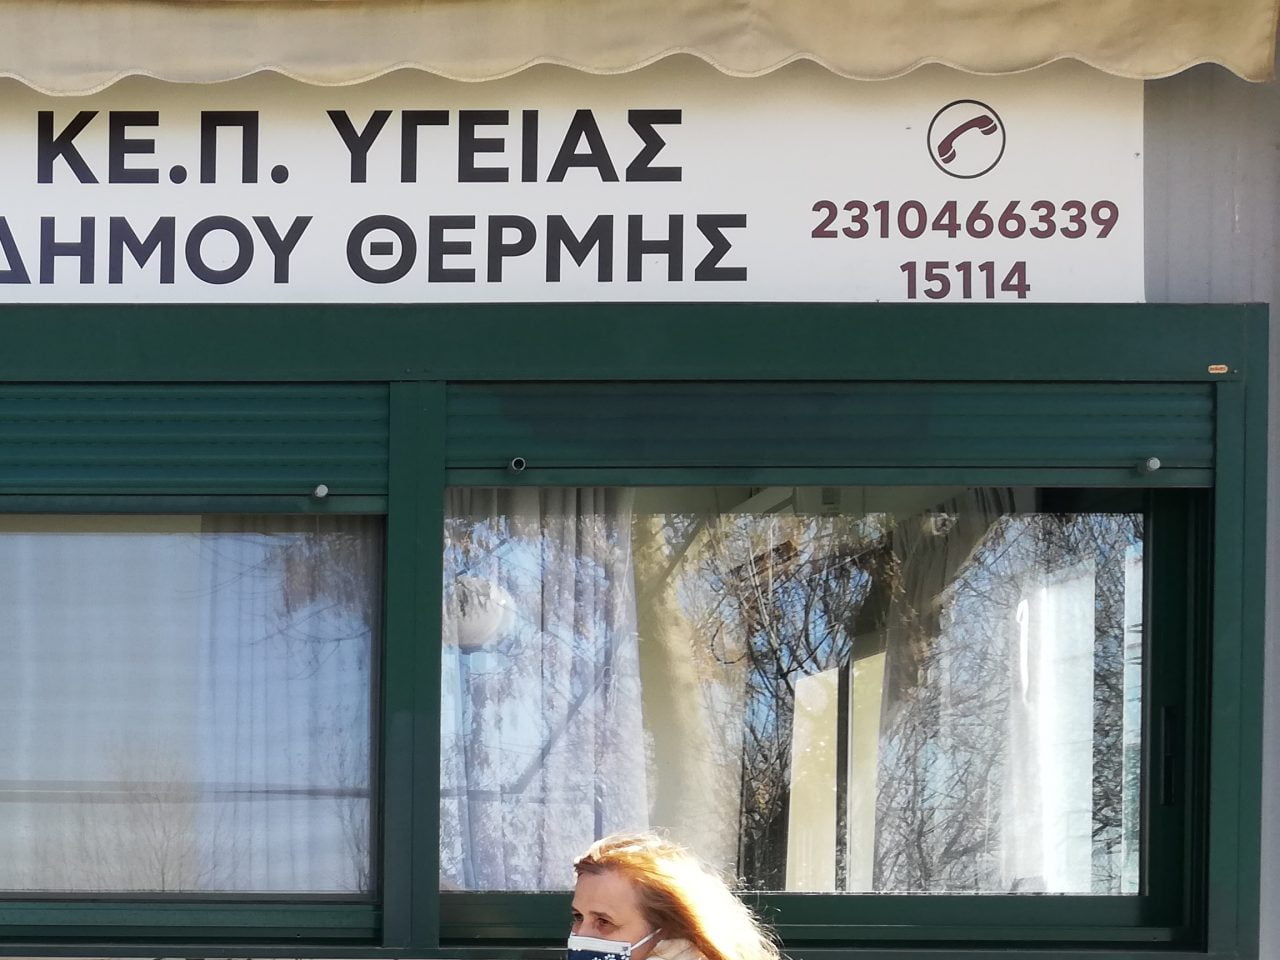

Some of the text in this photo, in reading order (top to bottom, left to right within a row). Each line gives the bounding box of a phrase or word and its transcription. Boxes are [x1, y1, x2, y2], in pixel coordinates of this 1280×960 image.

[37, 109, 683, 185] ΚΕ.Π. ΥΓΕΙΑΣ
[811, 199, 1119, 239] 2310466339
[346, 213, 748, 285] ΘΕΡΜΗΣ
[899, 260, 1031, 300] 15114
